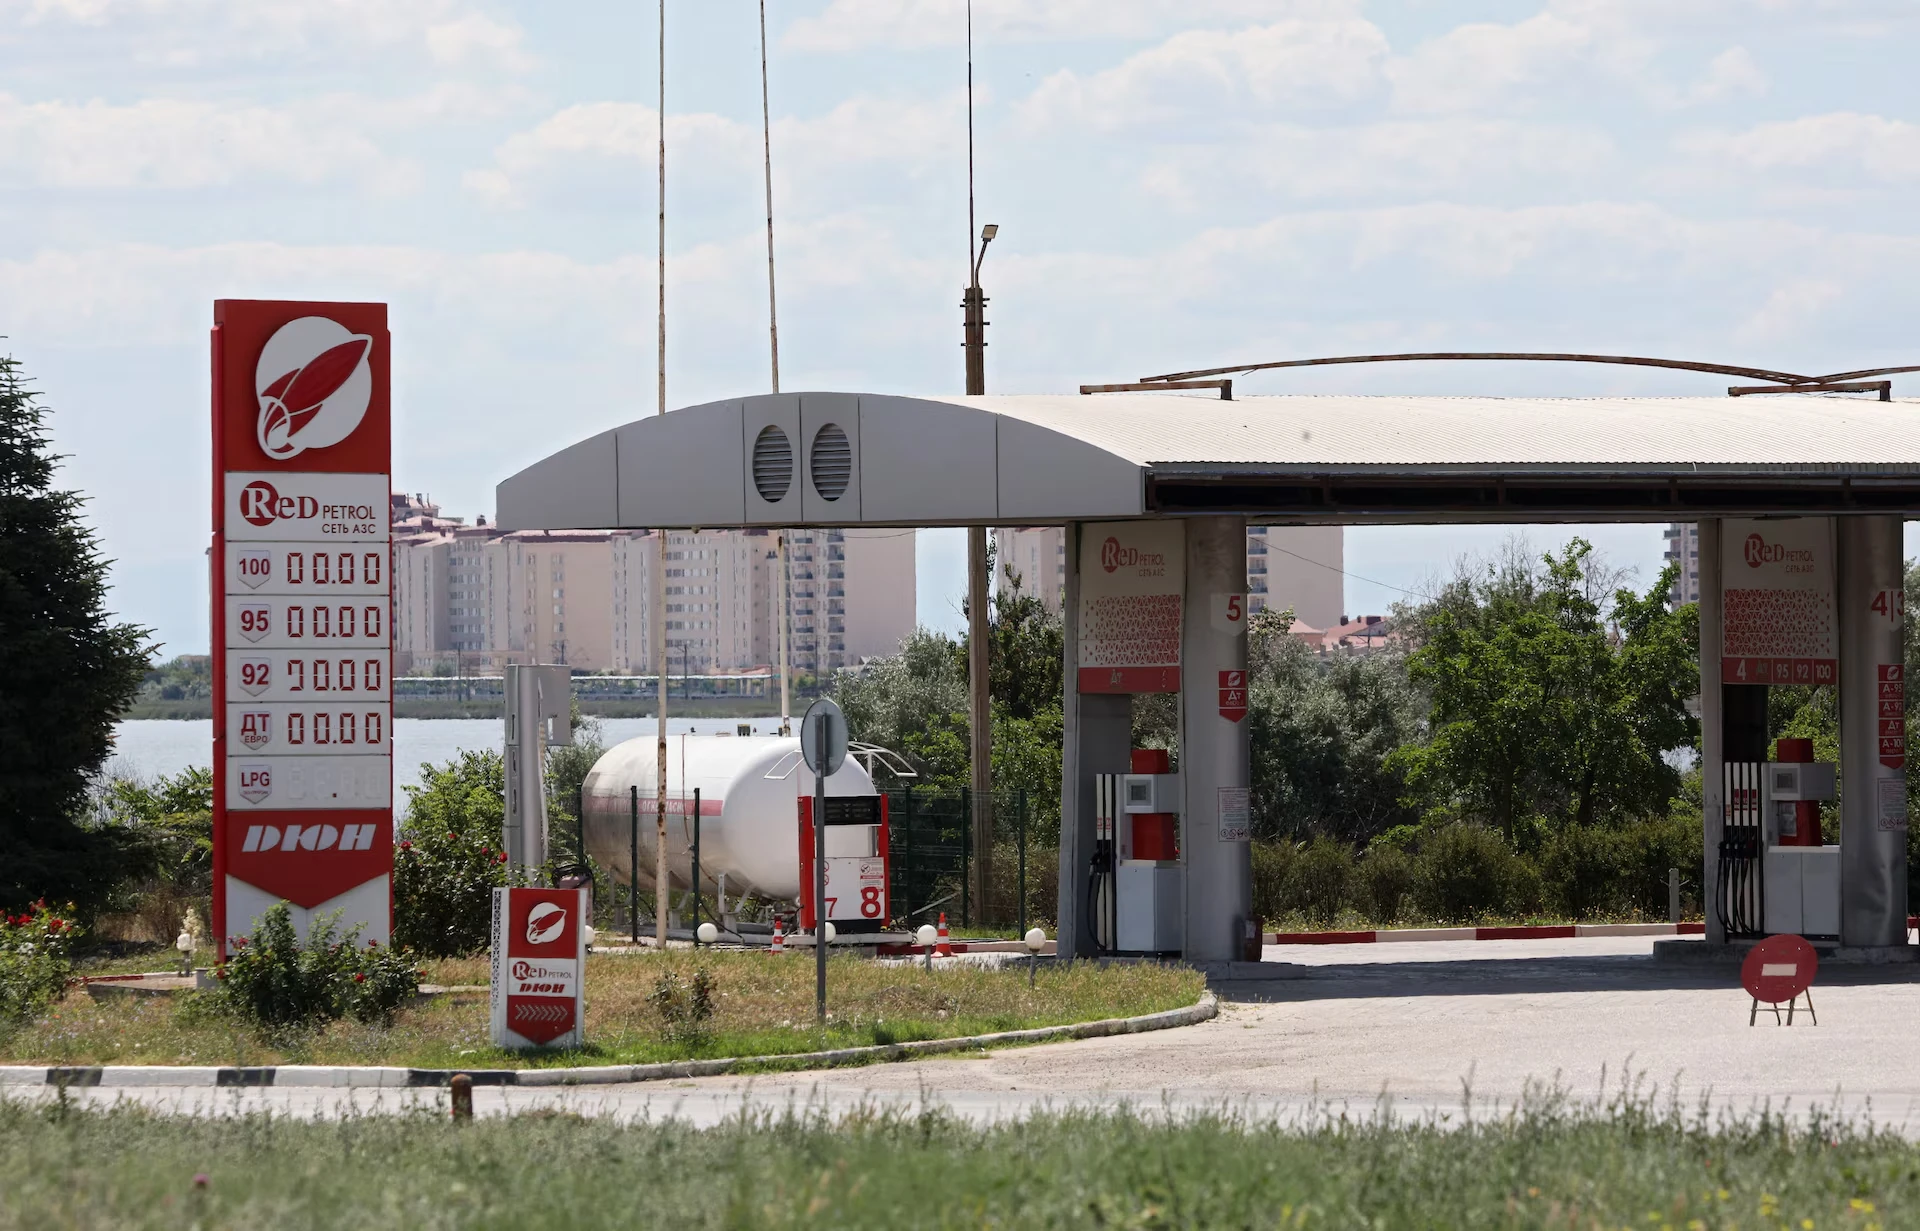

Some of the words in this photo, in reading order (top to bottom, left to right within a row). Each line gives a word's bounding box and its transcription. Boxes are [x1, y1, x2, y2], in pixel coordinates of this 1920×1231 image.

[322, 505, 376, 520] PETROL
[321, 523, 349, 534] СЕТЬ
[352, 523, 376, 534] АЗС
[1785, 550, 1815, 562] PETROL
[238, 558, 271, 576] 100
[287, 552, 380, 585] 00.00
[1226, 595, 1241, 622] 5
[240, 609, 269, 632] 95
[287, 606, 381, 638] 00.00
[241, 663, 270, 686] 92
[1736, 658, 1747, 681] 4
[1776, 663, 1789, 680] 95
[1796, 663, 1809, 680] 92
[1815, 664, 1832, 680] 100
[240, 713, 270, 736] ДТ
[287, 712, 381, 745] 00.00
[244, 735, 268, 744] ЕВРО
[240, 771, 270, 787] LPG
[824, 897, 838, 918] 7
[860, 886, 881, 919] 8
[548, 970, 572, 980] PETROL
